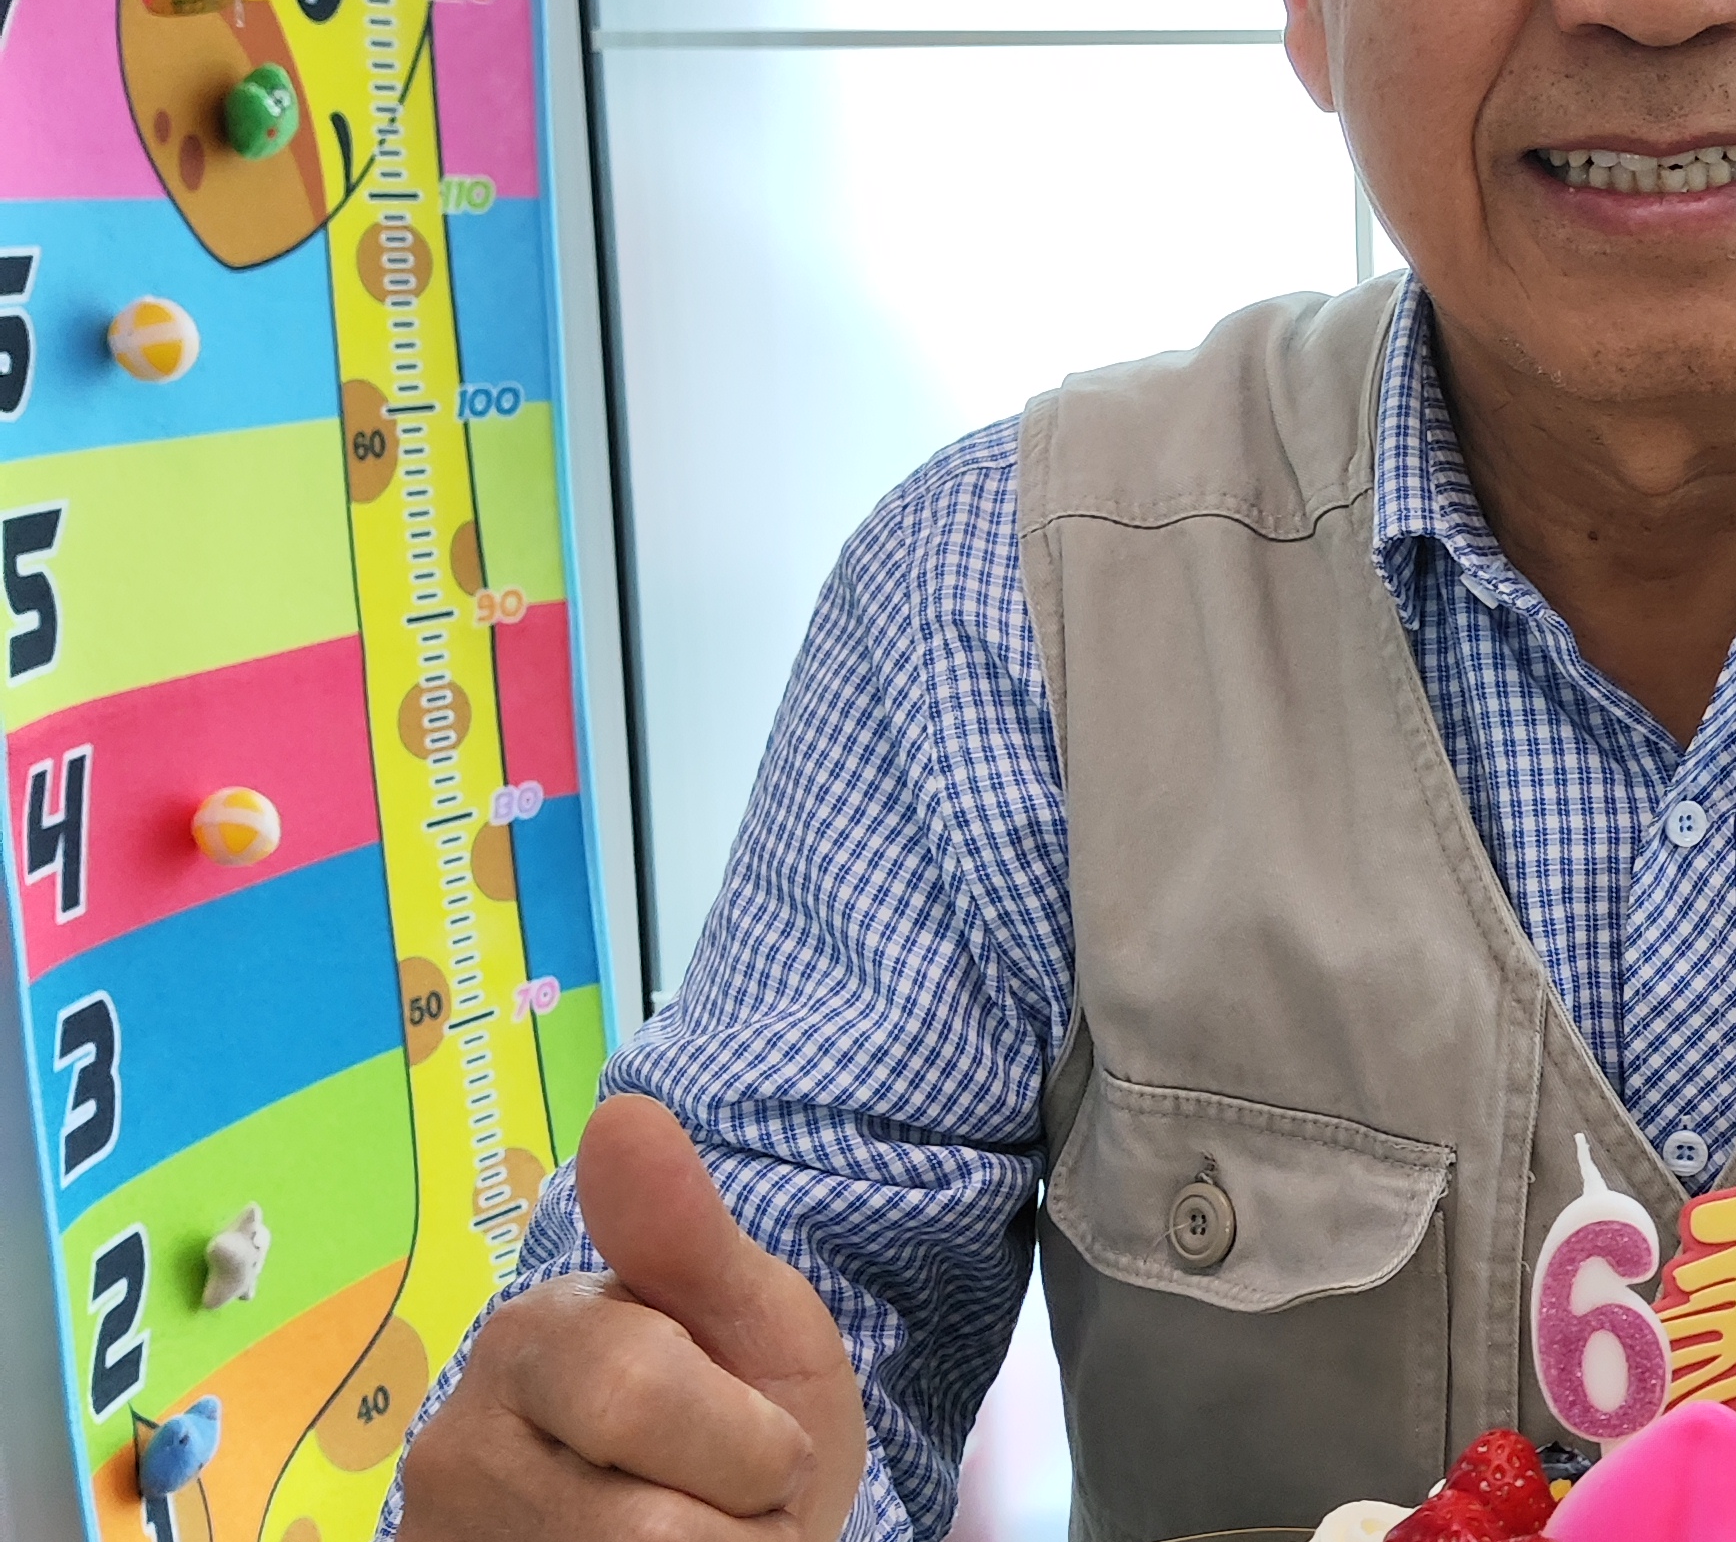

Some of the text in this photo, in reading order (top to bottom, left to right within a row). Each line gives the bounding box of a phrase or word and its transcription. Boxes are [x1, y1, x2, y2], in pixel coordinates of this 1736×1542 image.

[441, 177, 494, 214] 110
[458, 385, 522, 420] 100
[352, 428, 387, 461] 60
[1, 502, 66, 683] 5
[476, 590, 525, 624] 90
[491, 783, 543, 824] 80
[25, 745, 92, 921] 4
[408, 989, 442, 1027] 50
[514, 977, 559, 1021] 70
[55, 993, 120, 1186] 3
[89, 1225, 150, 1421] 2
[357, 1384, 391, 1427] 40
